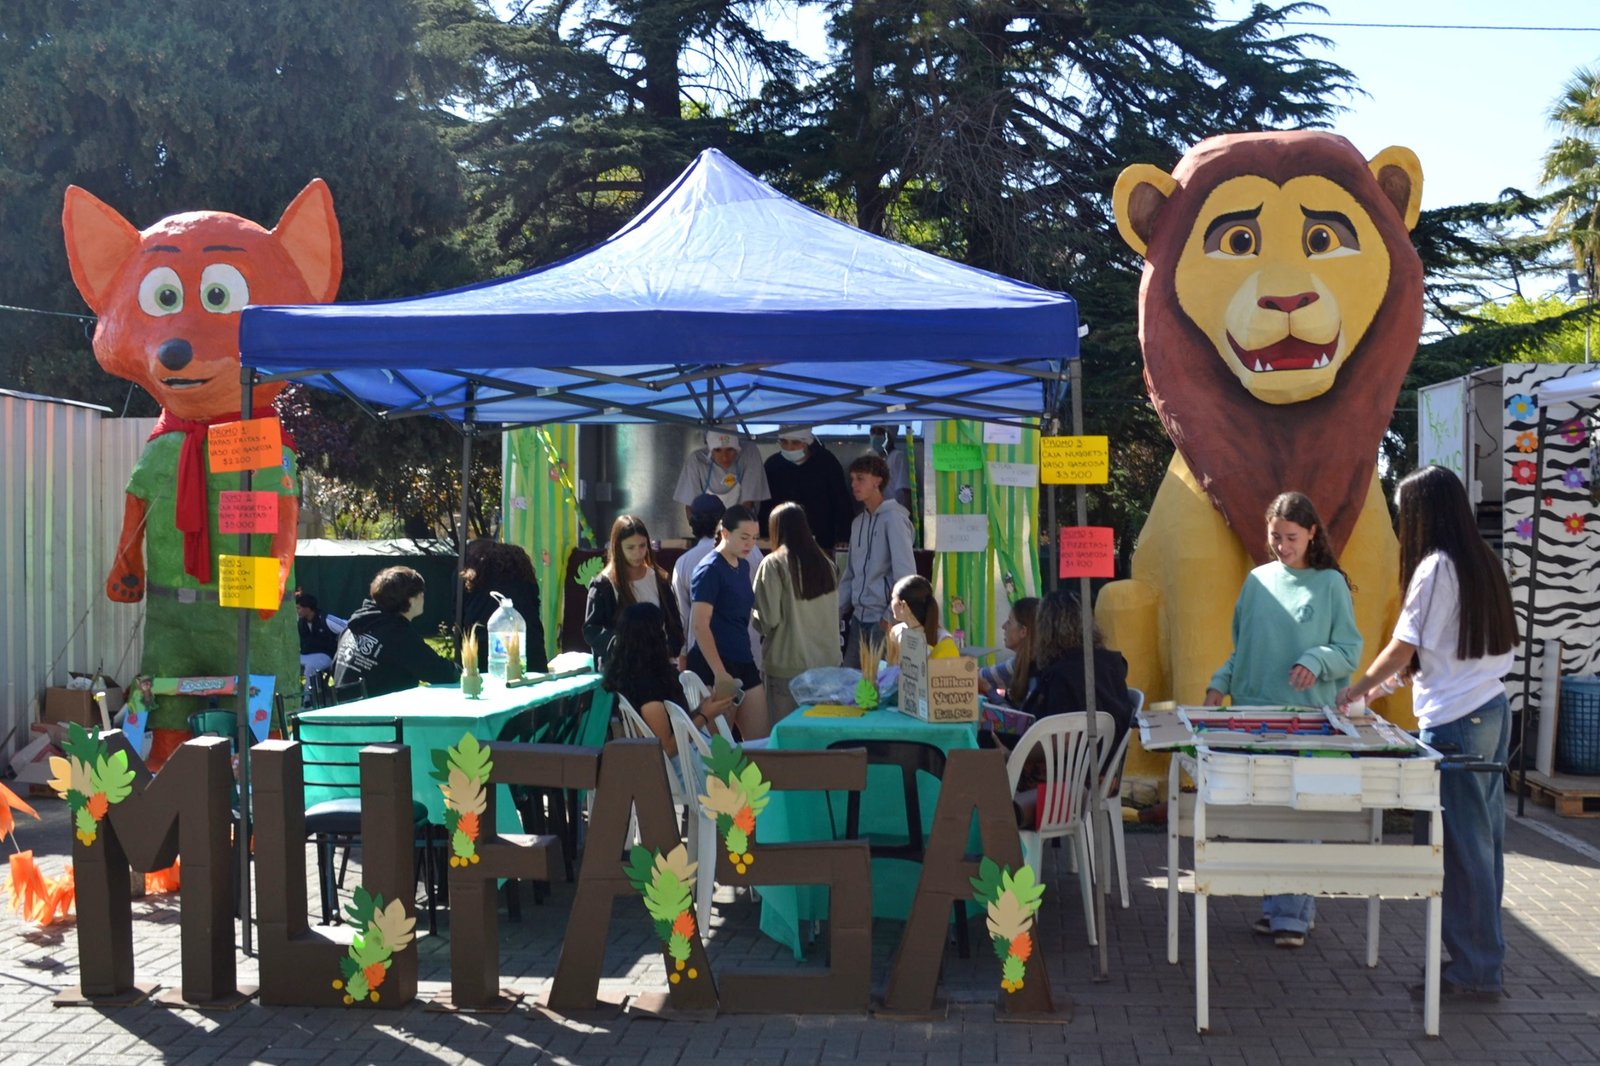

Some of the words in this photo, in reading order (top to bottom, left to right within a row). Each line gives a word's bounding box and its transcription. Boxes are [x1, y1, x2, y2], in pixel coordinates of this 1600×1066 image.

[1042, 439, 1073, 448] PROMO
[931, 676, 974, 688] Billiken
[70, 728, 1062, 1015] MUFASA
